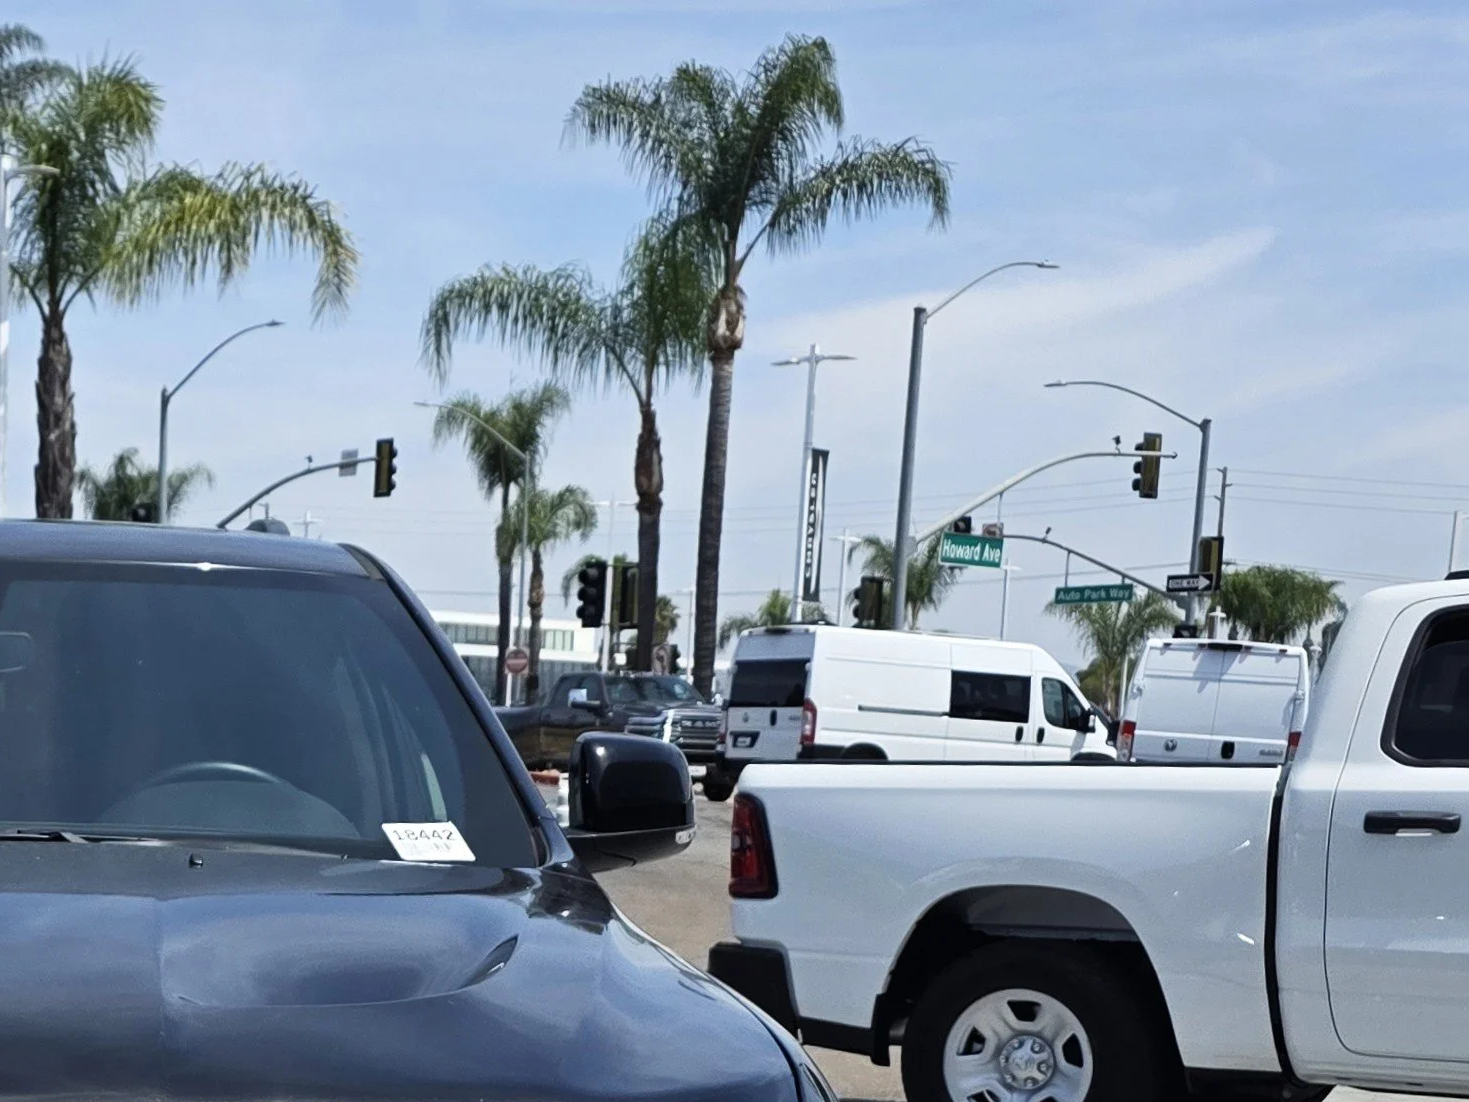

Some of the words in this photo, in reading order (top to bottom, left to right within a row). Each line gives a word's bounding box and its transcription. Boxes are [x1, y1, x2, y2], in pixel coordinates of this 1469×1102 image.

[942, 539, 982, 561] Howard
[982, 543, 1001, 562] Ave
[1057, 590, 1081, 600] Auto
[1084, 588, 1106, 599] Park
[1110, 587, 1130, 599] Way
[393, 829, 457, 841] 18442
